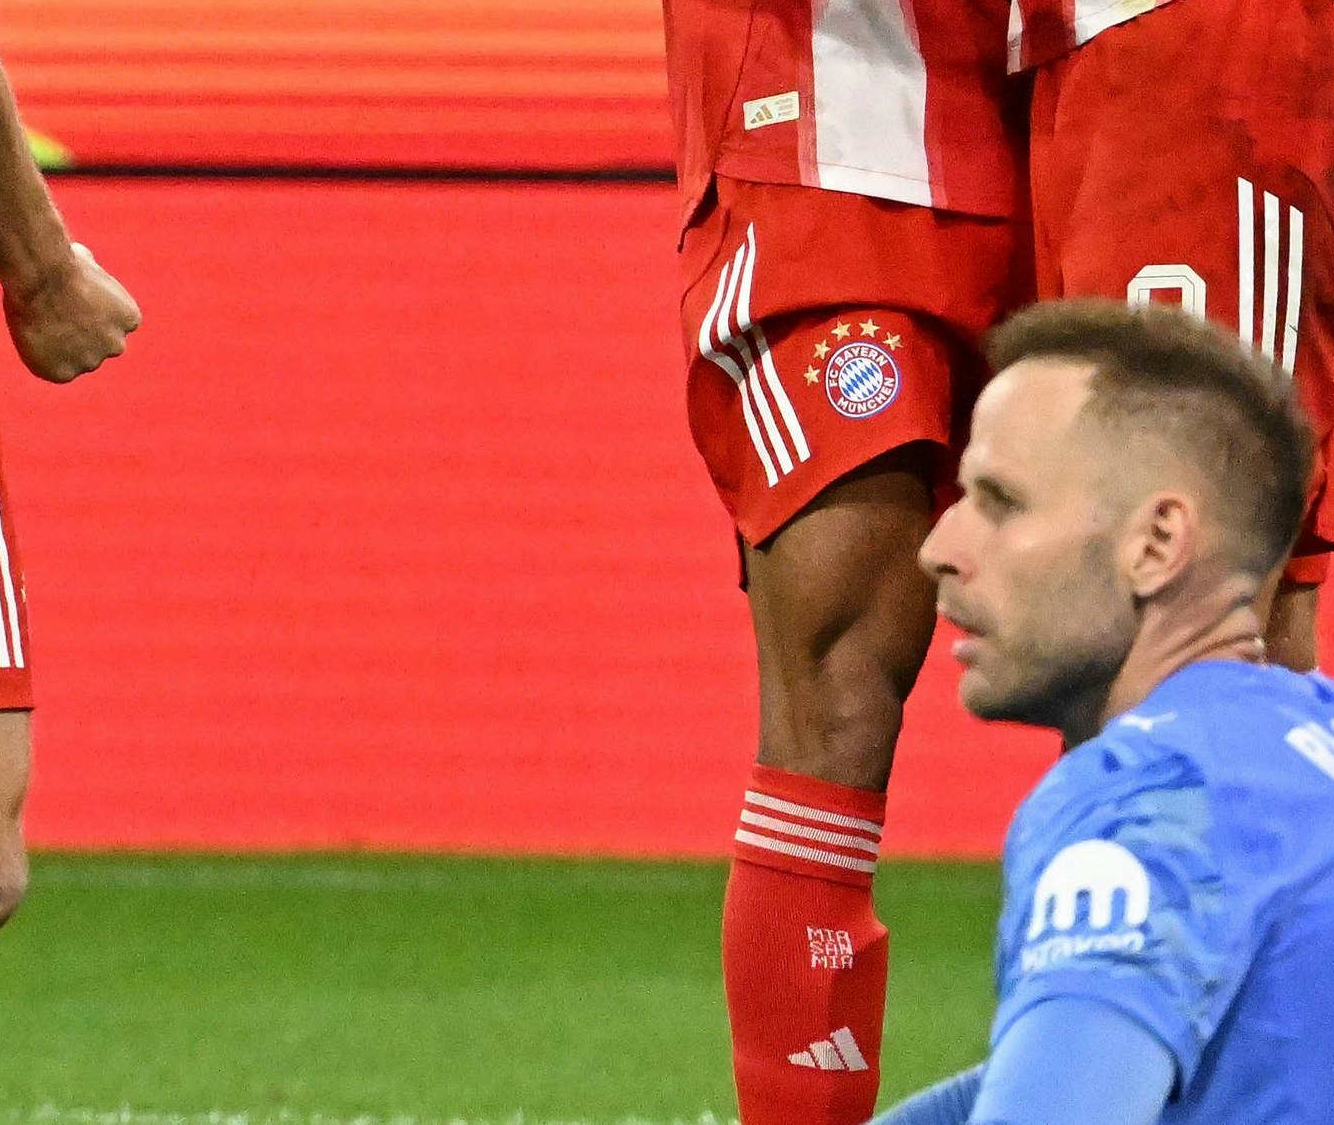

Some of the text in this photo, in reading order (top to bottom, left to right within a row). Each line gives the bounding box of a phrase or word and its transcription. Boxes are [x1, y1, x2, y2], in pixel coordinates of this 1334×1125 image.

[828, 346, 888, 388] FC BAYERN
[807, 926, 851, 945] MIA
[810, 941, 853, 956] SAN
[811, 955, 853, 969] MIA
